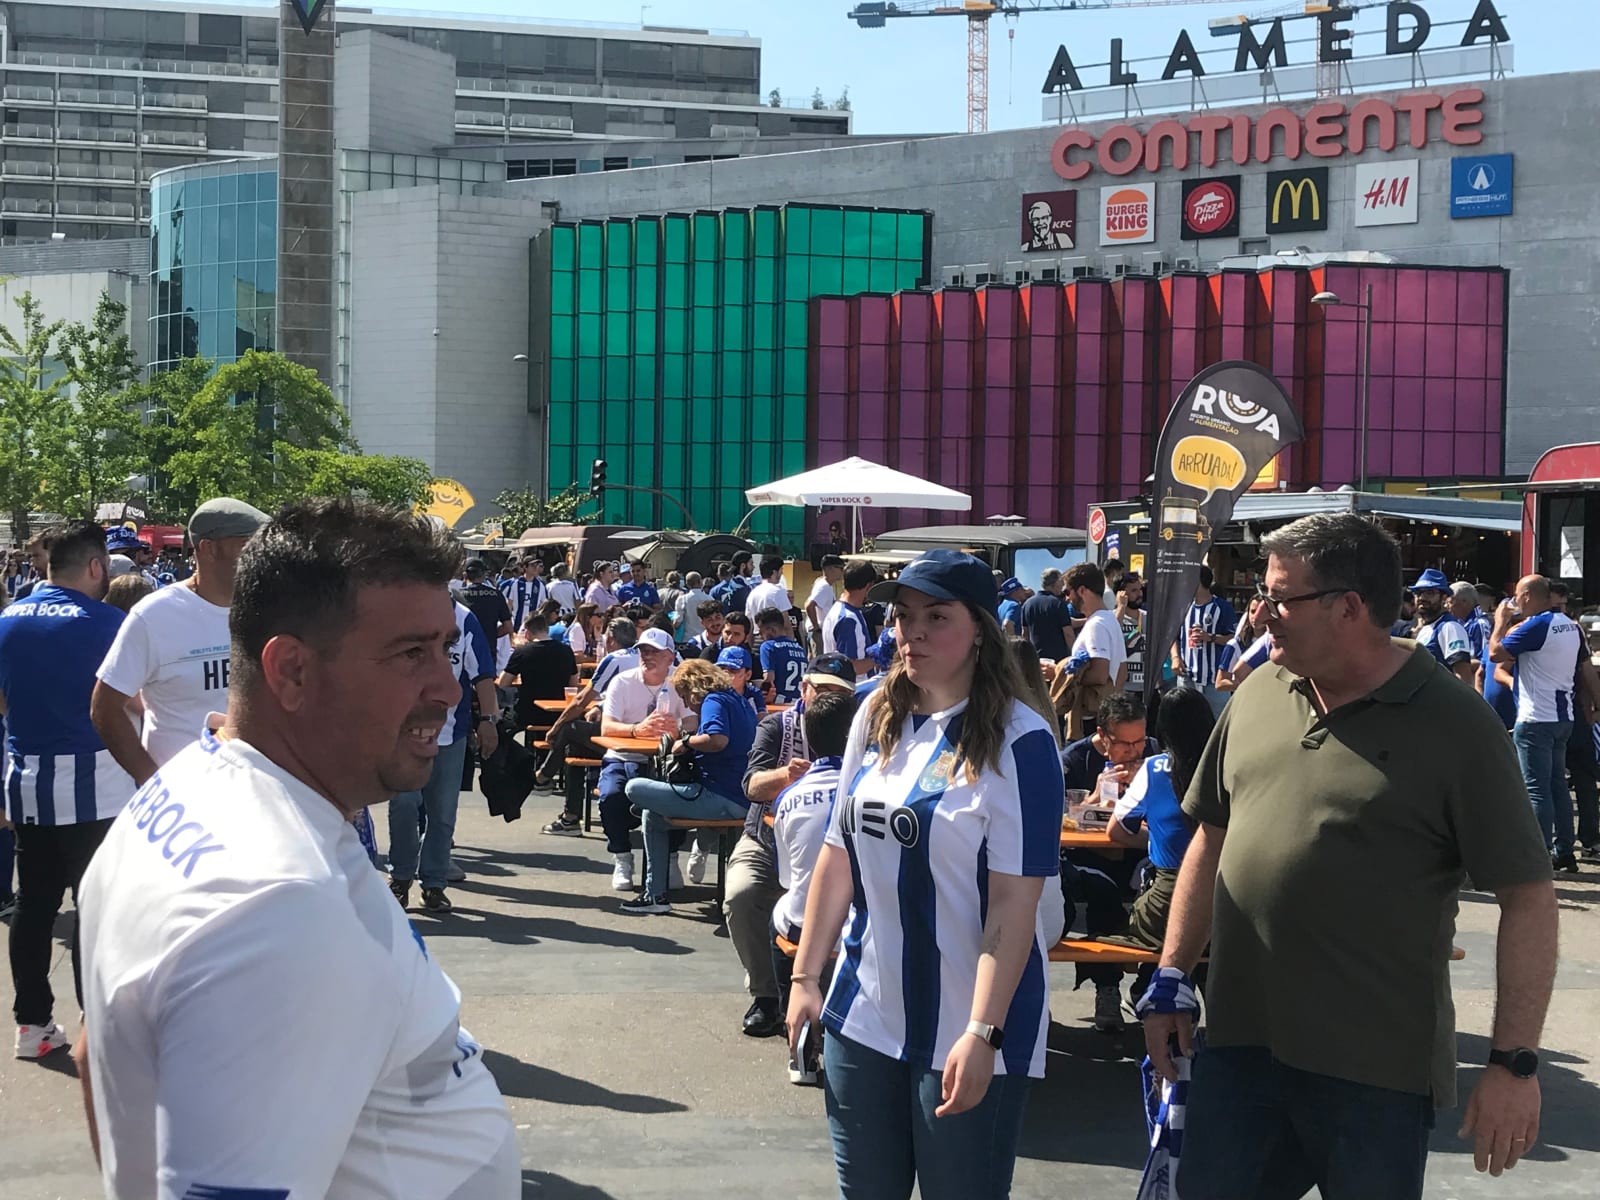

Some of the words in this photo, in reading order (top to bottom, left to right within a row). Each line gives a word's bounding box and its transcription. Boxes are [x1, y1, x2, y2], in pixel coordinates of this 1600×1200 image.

[1041, 0, 1511, 93] ALAMEDA
[1050, 88, 1484, 181] CONTINENTE
[1364, 176, 1409, 209] H&M
[1106, 203, 1148, 216] BURGER
[1052, 220, 1073, 229] KFC
[1106, 215, 1148, 231] KING
[1191, 384, 1280, 441] RUA
[126, 506, 146, 518] RUA
[37, 602, 82, 618] BOCK
[779, 790, 823, 820] SUPER
